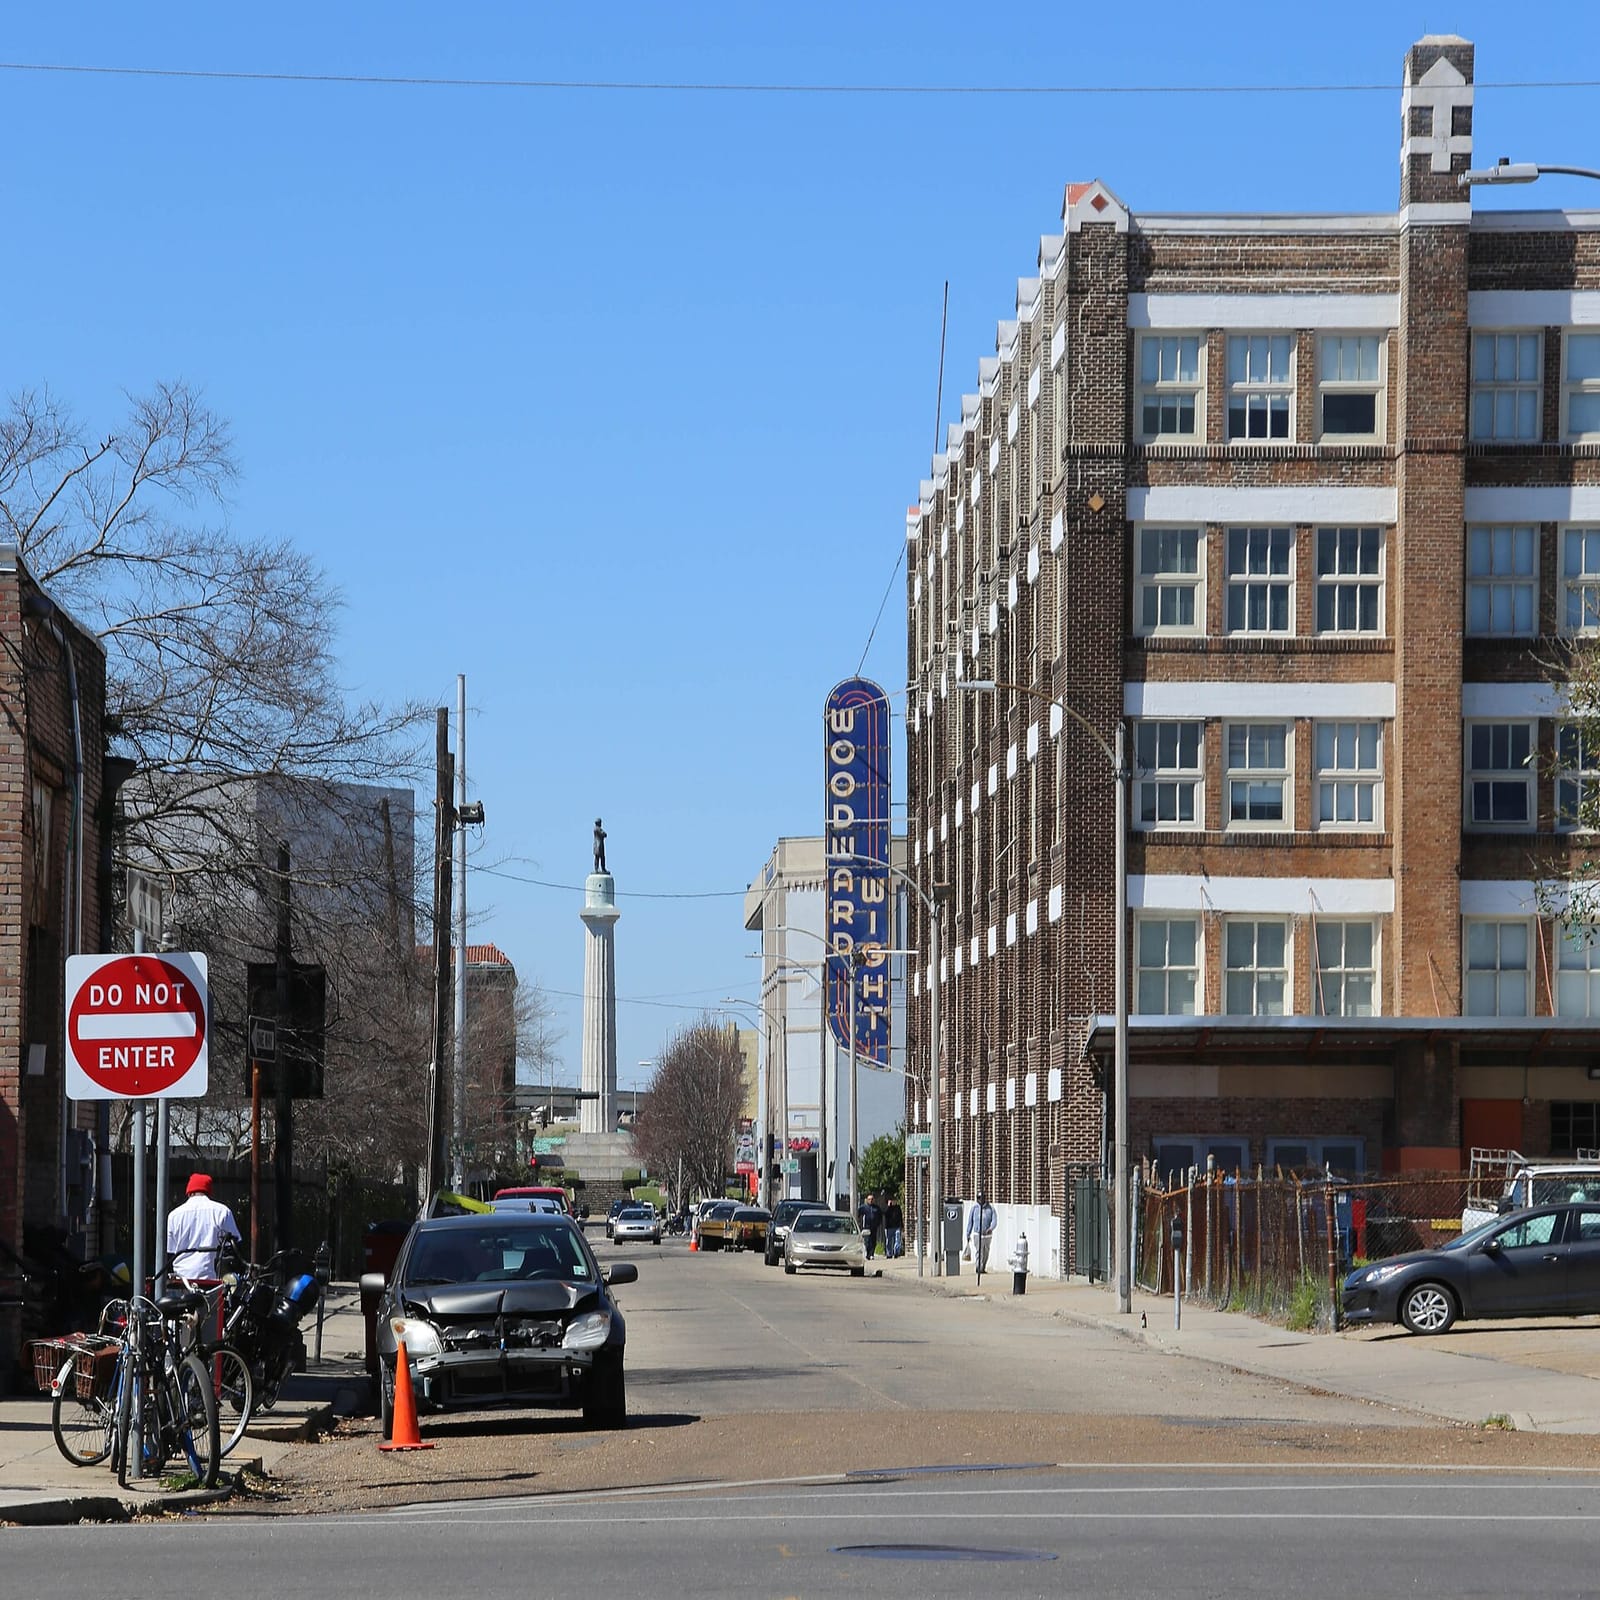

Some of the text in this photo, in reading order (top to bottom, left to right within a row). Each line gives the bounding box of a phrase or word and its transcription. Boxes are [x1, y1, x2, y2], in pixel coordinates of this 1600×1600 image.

[830, 708, 856, 956] WOODWARD
[89, 983, 185, 1007] DO NOT
[861, 877, 887, 1031] WIGHT
[99, 1045, 175, 1069] ENTER
